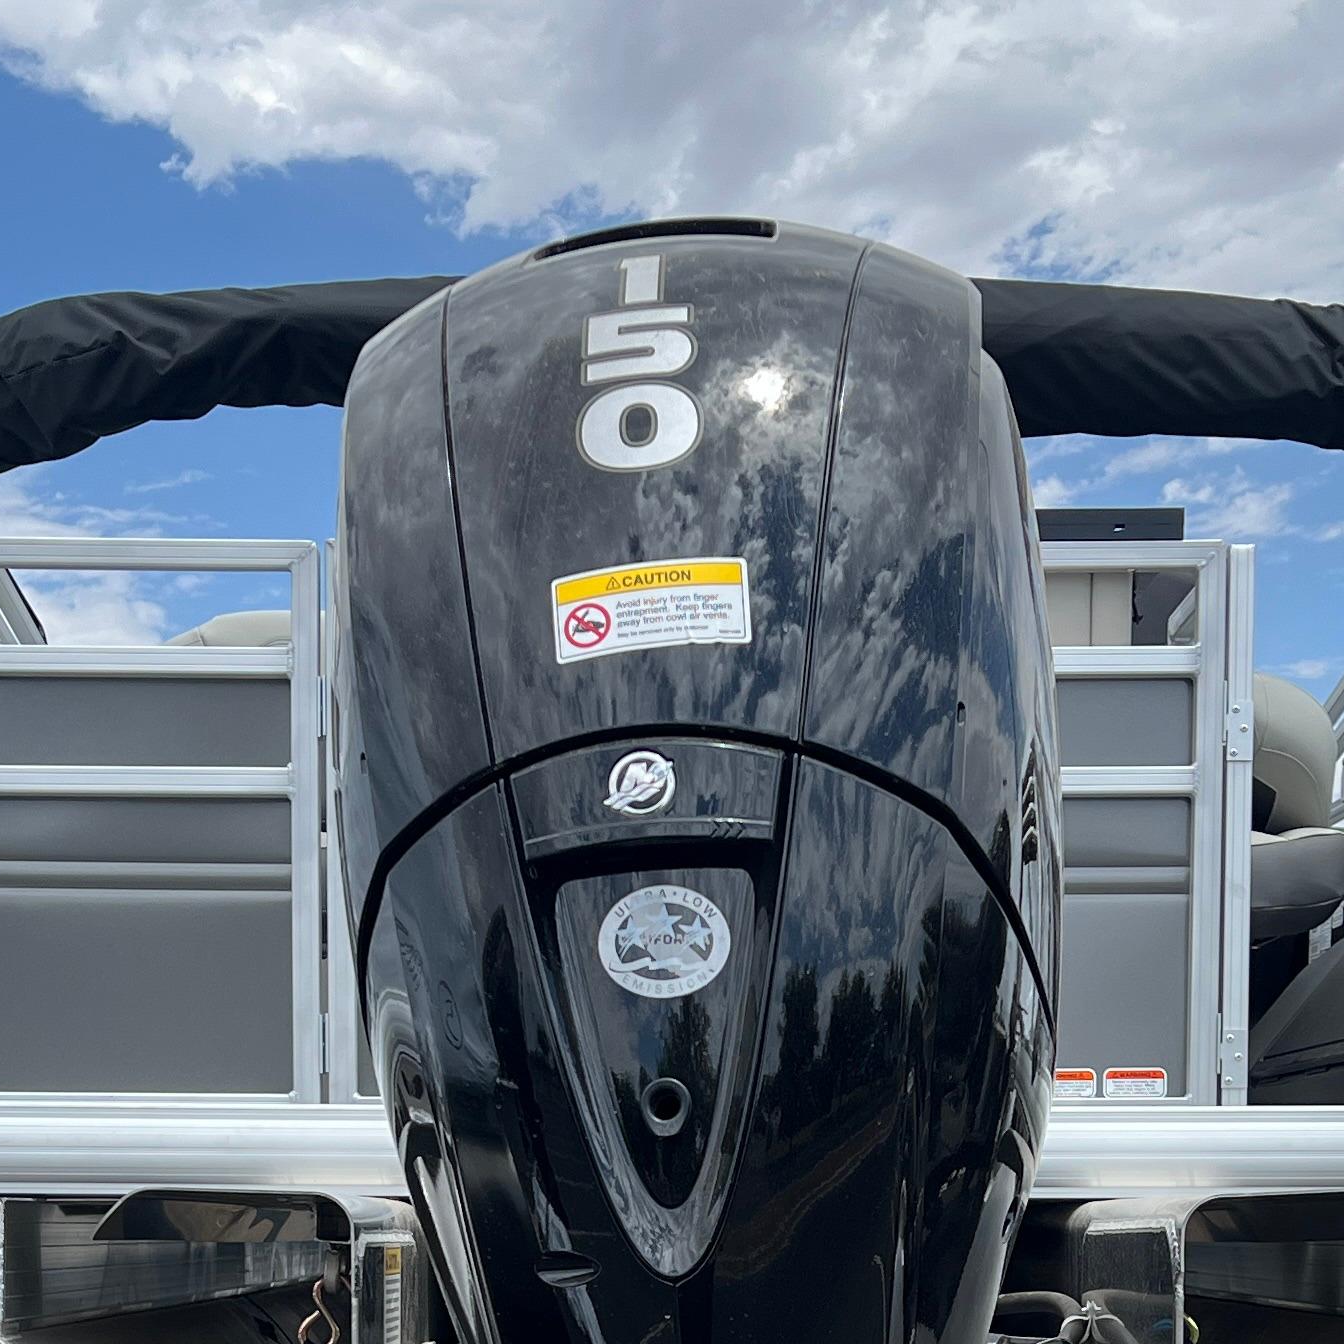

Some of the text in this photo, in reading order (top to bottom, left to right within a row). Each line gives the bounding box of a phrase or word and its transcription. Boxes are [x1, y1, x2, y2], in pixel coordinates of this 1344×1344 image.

[576, 253, 705, 473] 150
[622, 569, 692, 588] CAUTION
[616, 593, 719, 609] Avoid injury from finger
[675, 603, 699, 613] Keep
[702, 602, 733, 612] fingers
[617, 619, 641, 628] away
[643, 616, 664, 624] from
[666, 613, 687, 621] cowl
[689, 612, 700, 620] air
[682, 892, 718, 918] LOW
[622, 968, 708, 994] EMISSION
